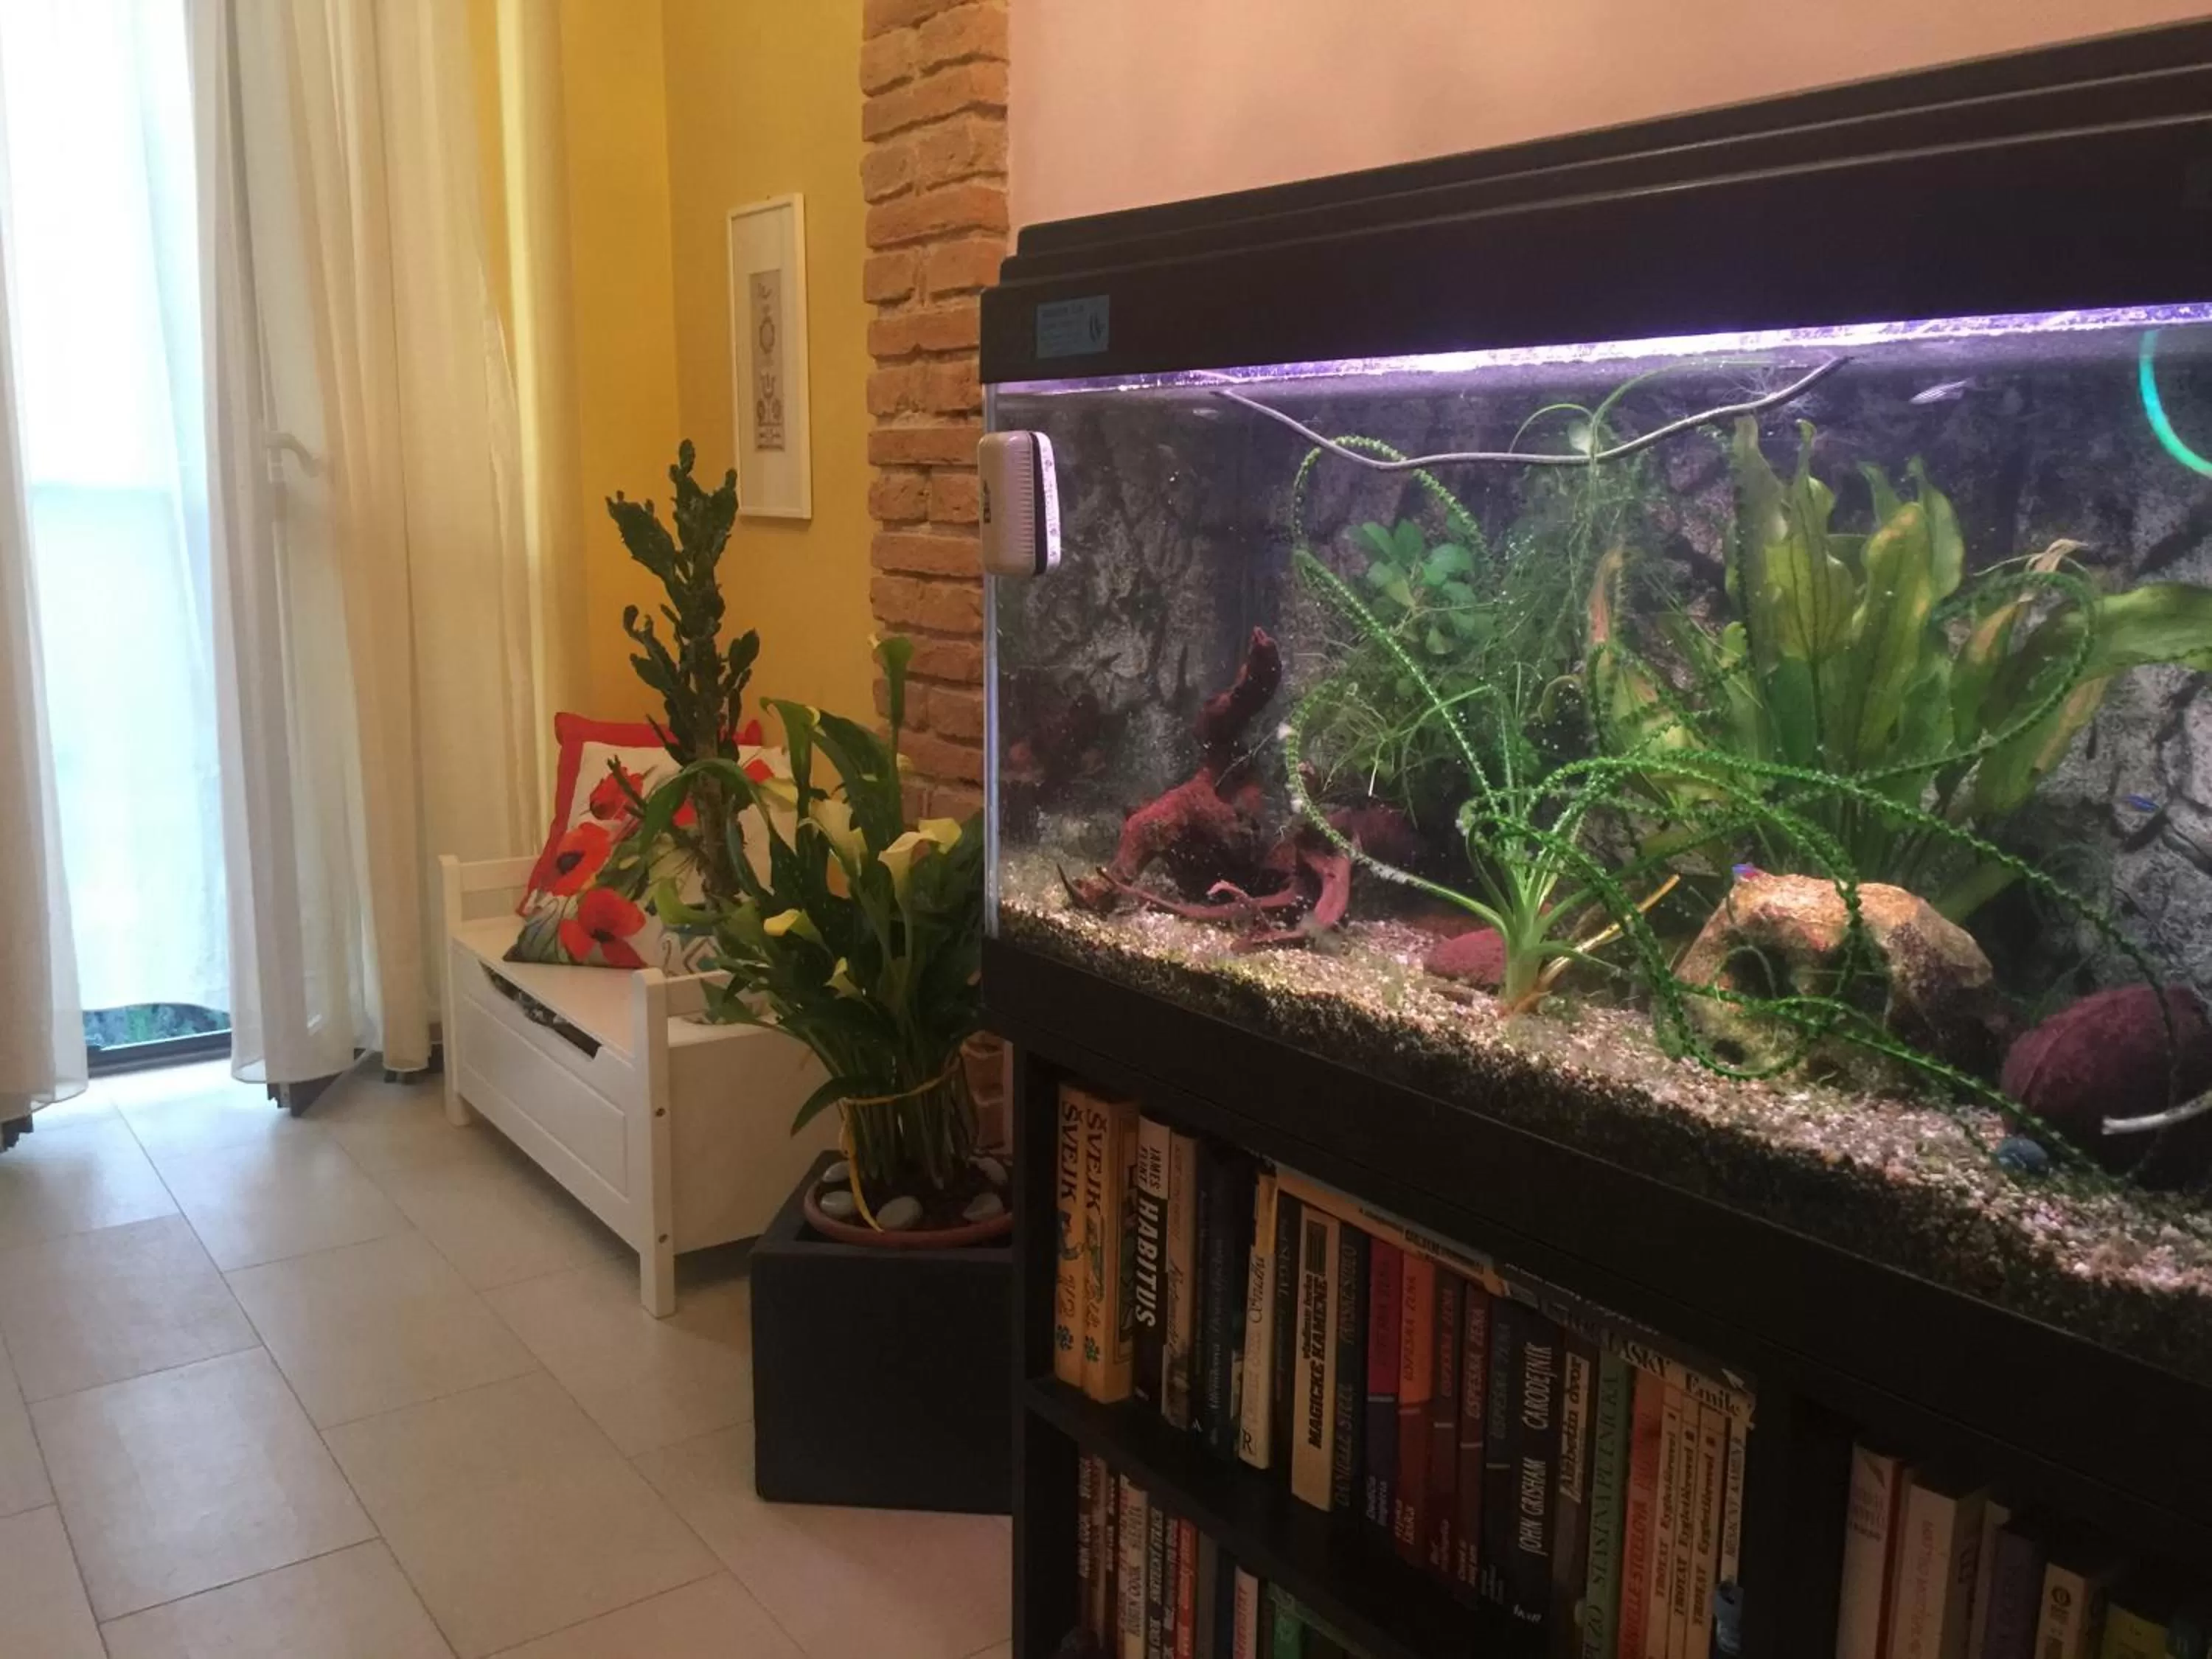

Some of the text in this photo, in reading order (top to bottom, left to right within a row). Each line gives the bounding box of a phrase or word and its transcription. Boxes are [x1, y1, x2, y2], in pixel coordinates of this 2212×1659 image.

[1061, 1103, 1084, 1204] ŠVEJK
[1085, 1108, 1108, 1215] ŠVEJK
[1150, 1144, 1162, 1191] JAMES
[1135, 1198, 1159, 1328] HABITUS
[1517, 1456, 1549, 1557] JOHN GRISHAM
